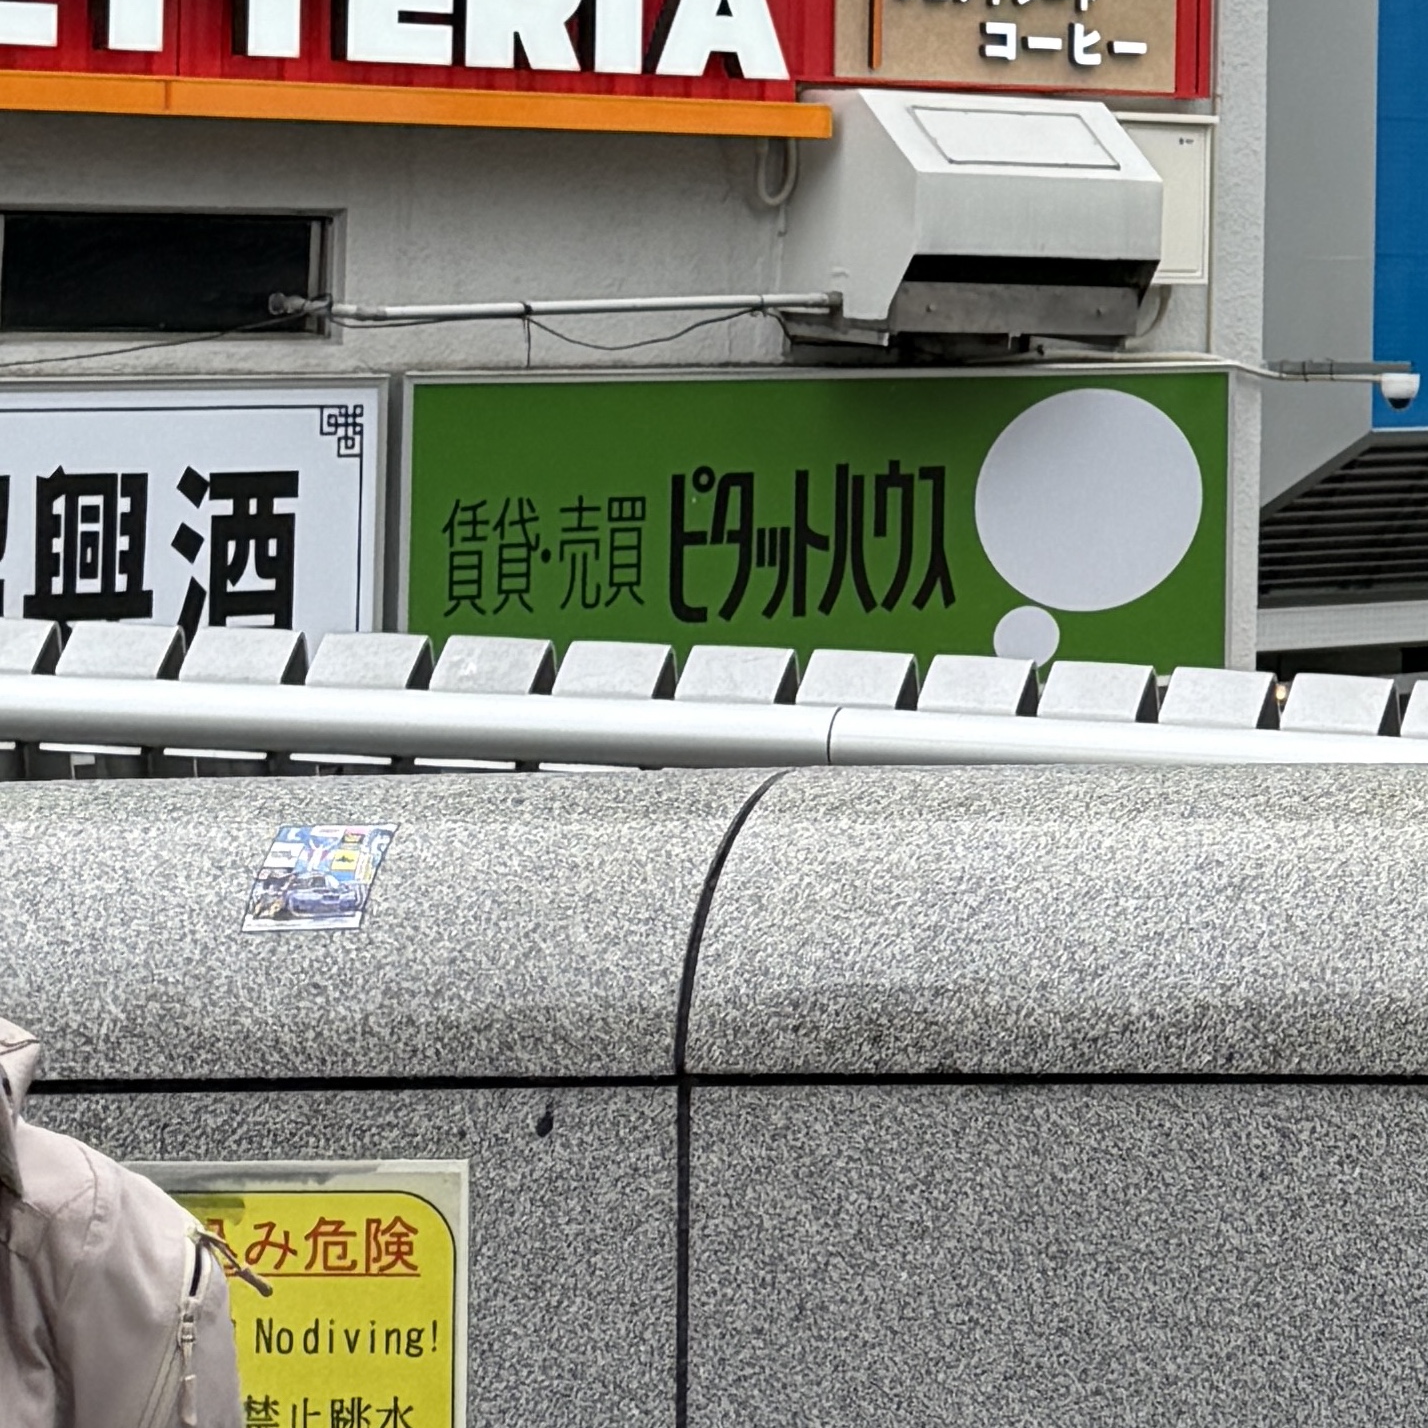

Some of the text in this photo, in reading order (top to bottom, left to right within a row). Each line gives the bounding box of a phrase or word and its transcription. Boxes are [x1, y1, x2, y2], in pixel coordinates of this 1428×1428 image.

[983, 21, 1148, 66] コーヒー
[0, 464, 300, 640] 興酒
[442, 494, 648, 618] 賃貸・売買
[670, 459, 958, 624] ピタットハウス
